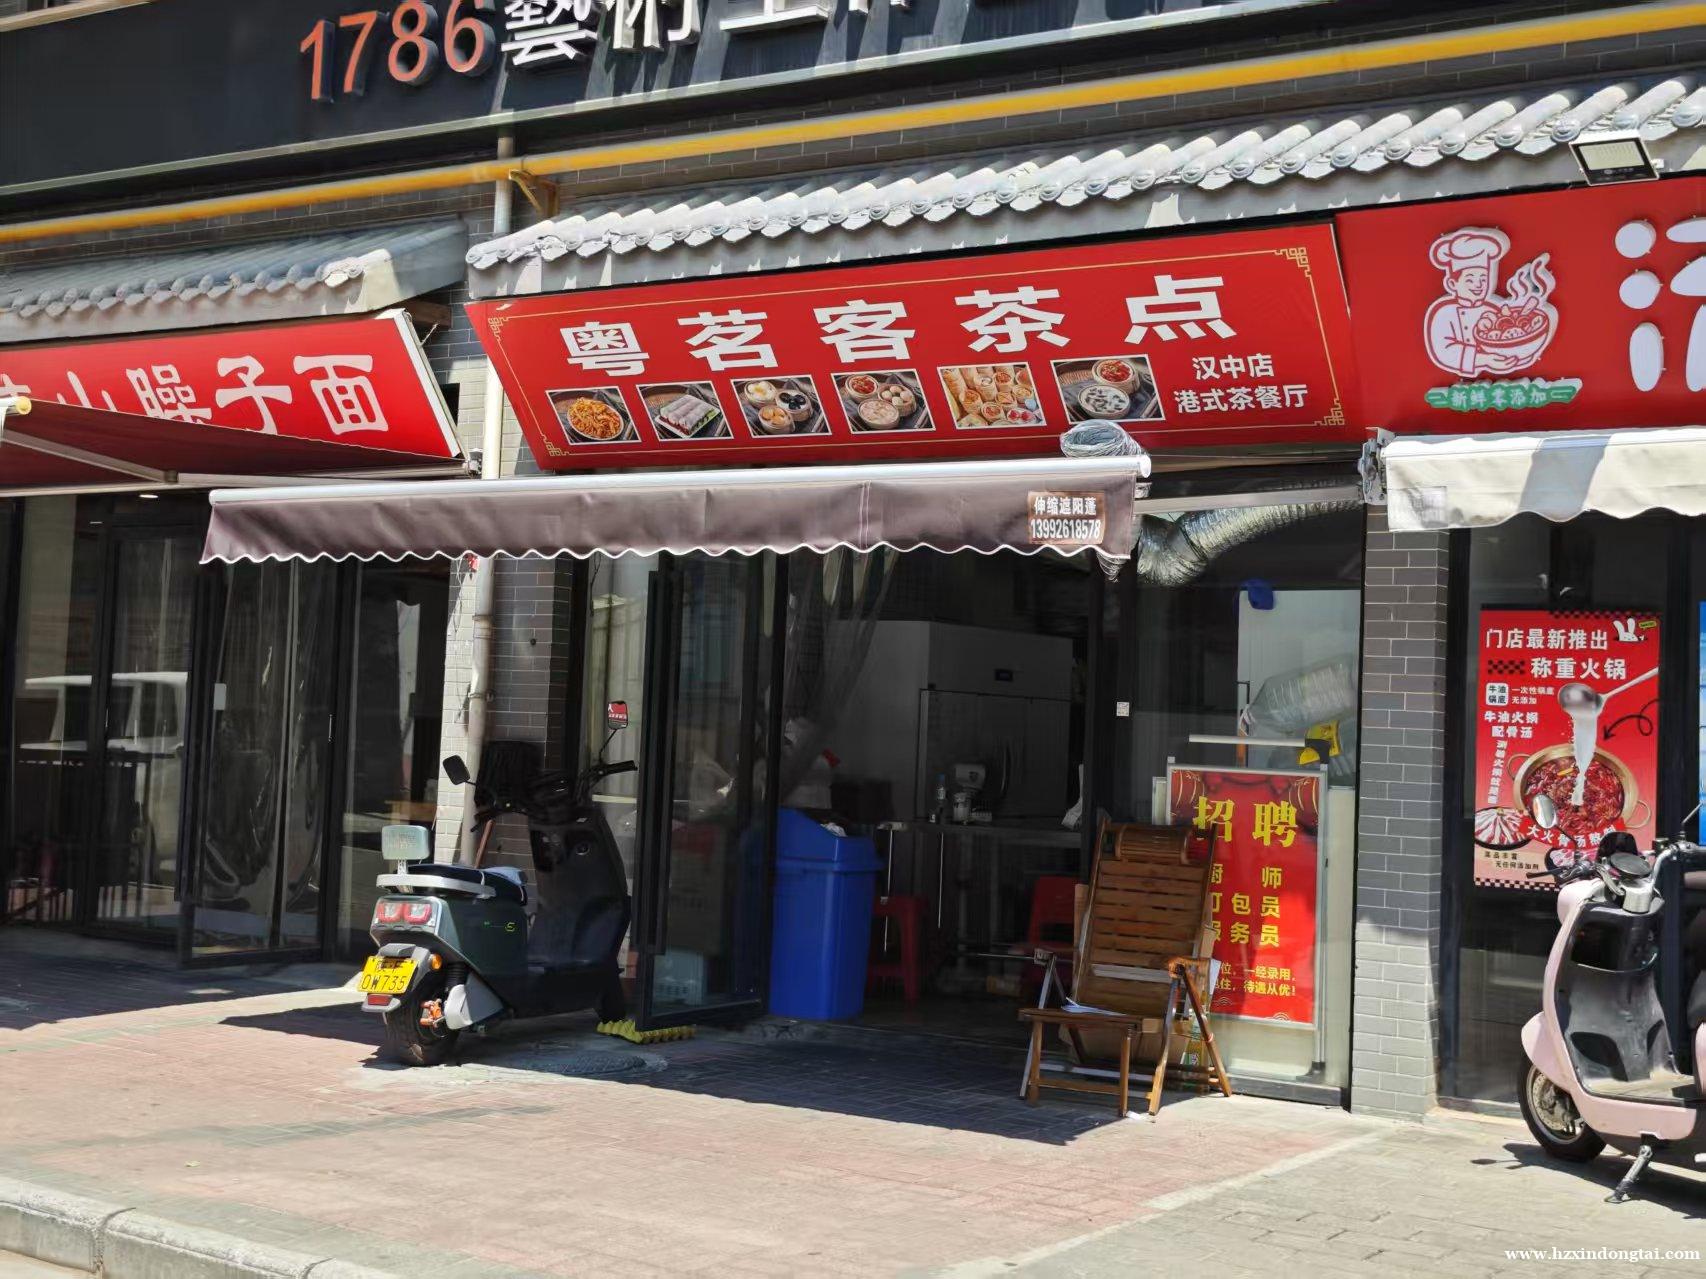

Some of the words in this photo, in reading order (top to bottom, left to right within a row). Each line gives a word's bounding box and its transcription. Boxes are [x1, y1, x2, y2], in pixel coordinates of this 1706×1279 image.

[299, 0, 490, 100] 1786
[559, 273, 1238, 377] 粤茗客茶点
[1191, 353, 1275, 381] 汉中店
[1173, 383, 1308, 414] 港式茶餐厅
[1450, 387, 1547, 409] 新鲜零添加
[1030, 518, 1102, 539] 13992618578
[1485, 627, 1608, 650] 门店最新推出
[1530, 657, 1627, 680] 称重火锅
[1484, 710, 1539, 724] 牛油火锅
[1192, 796, 1298, 848] 招聘
